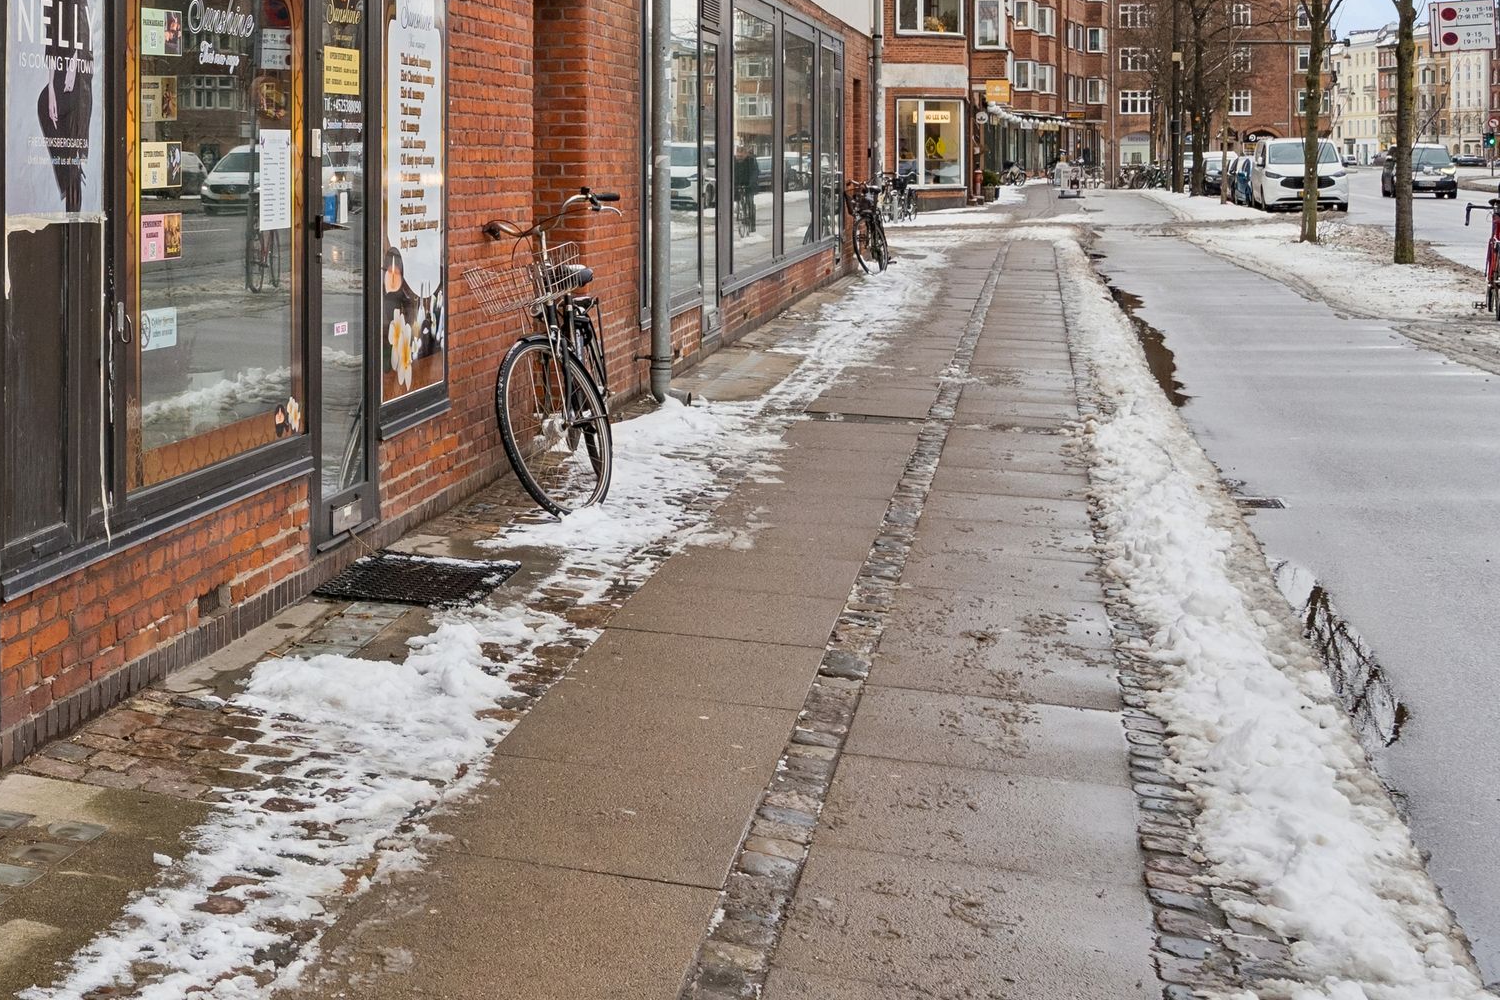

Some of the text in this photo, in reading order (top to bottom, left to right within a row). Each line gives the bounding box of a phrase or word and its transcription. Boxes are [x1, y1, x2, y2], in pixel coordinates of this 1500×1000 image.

[19, 51, 95, 75] IS COMING TO TOWN
